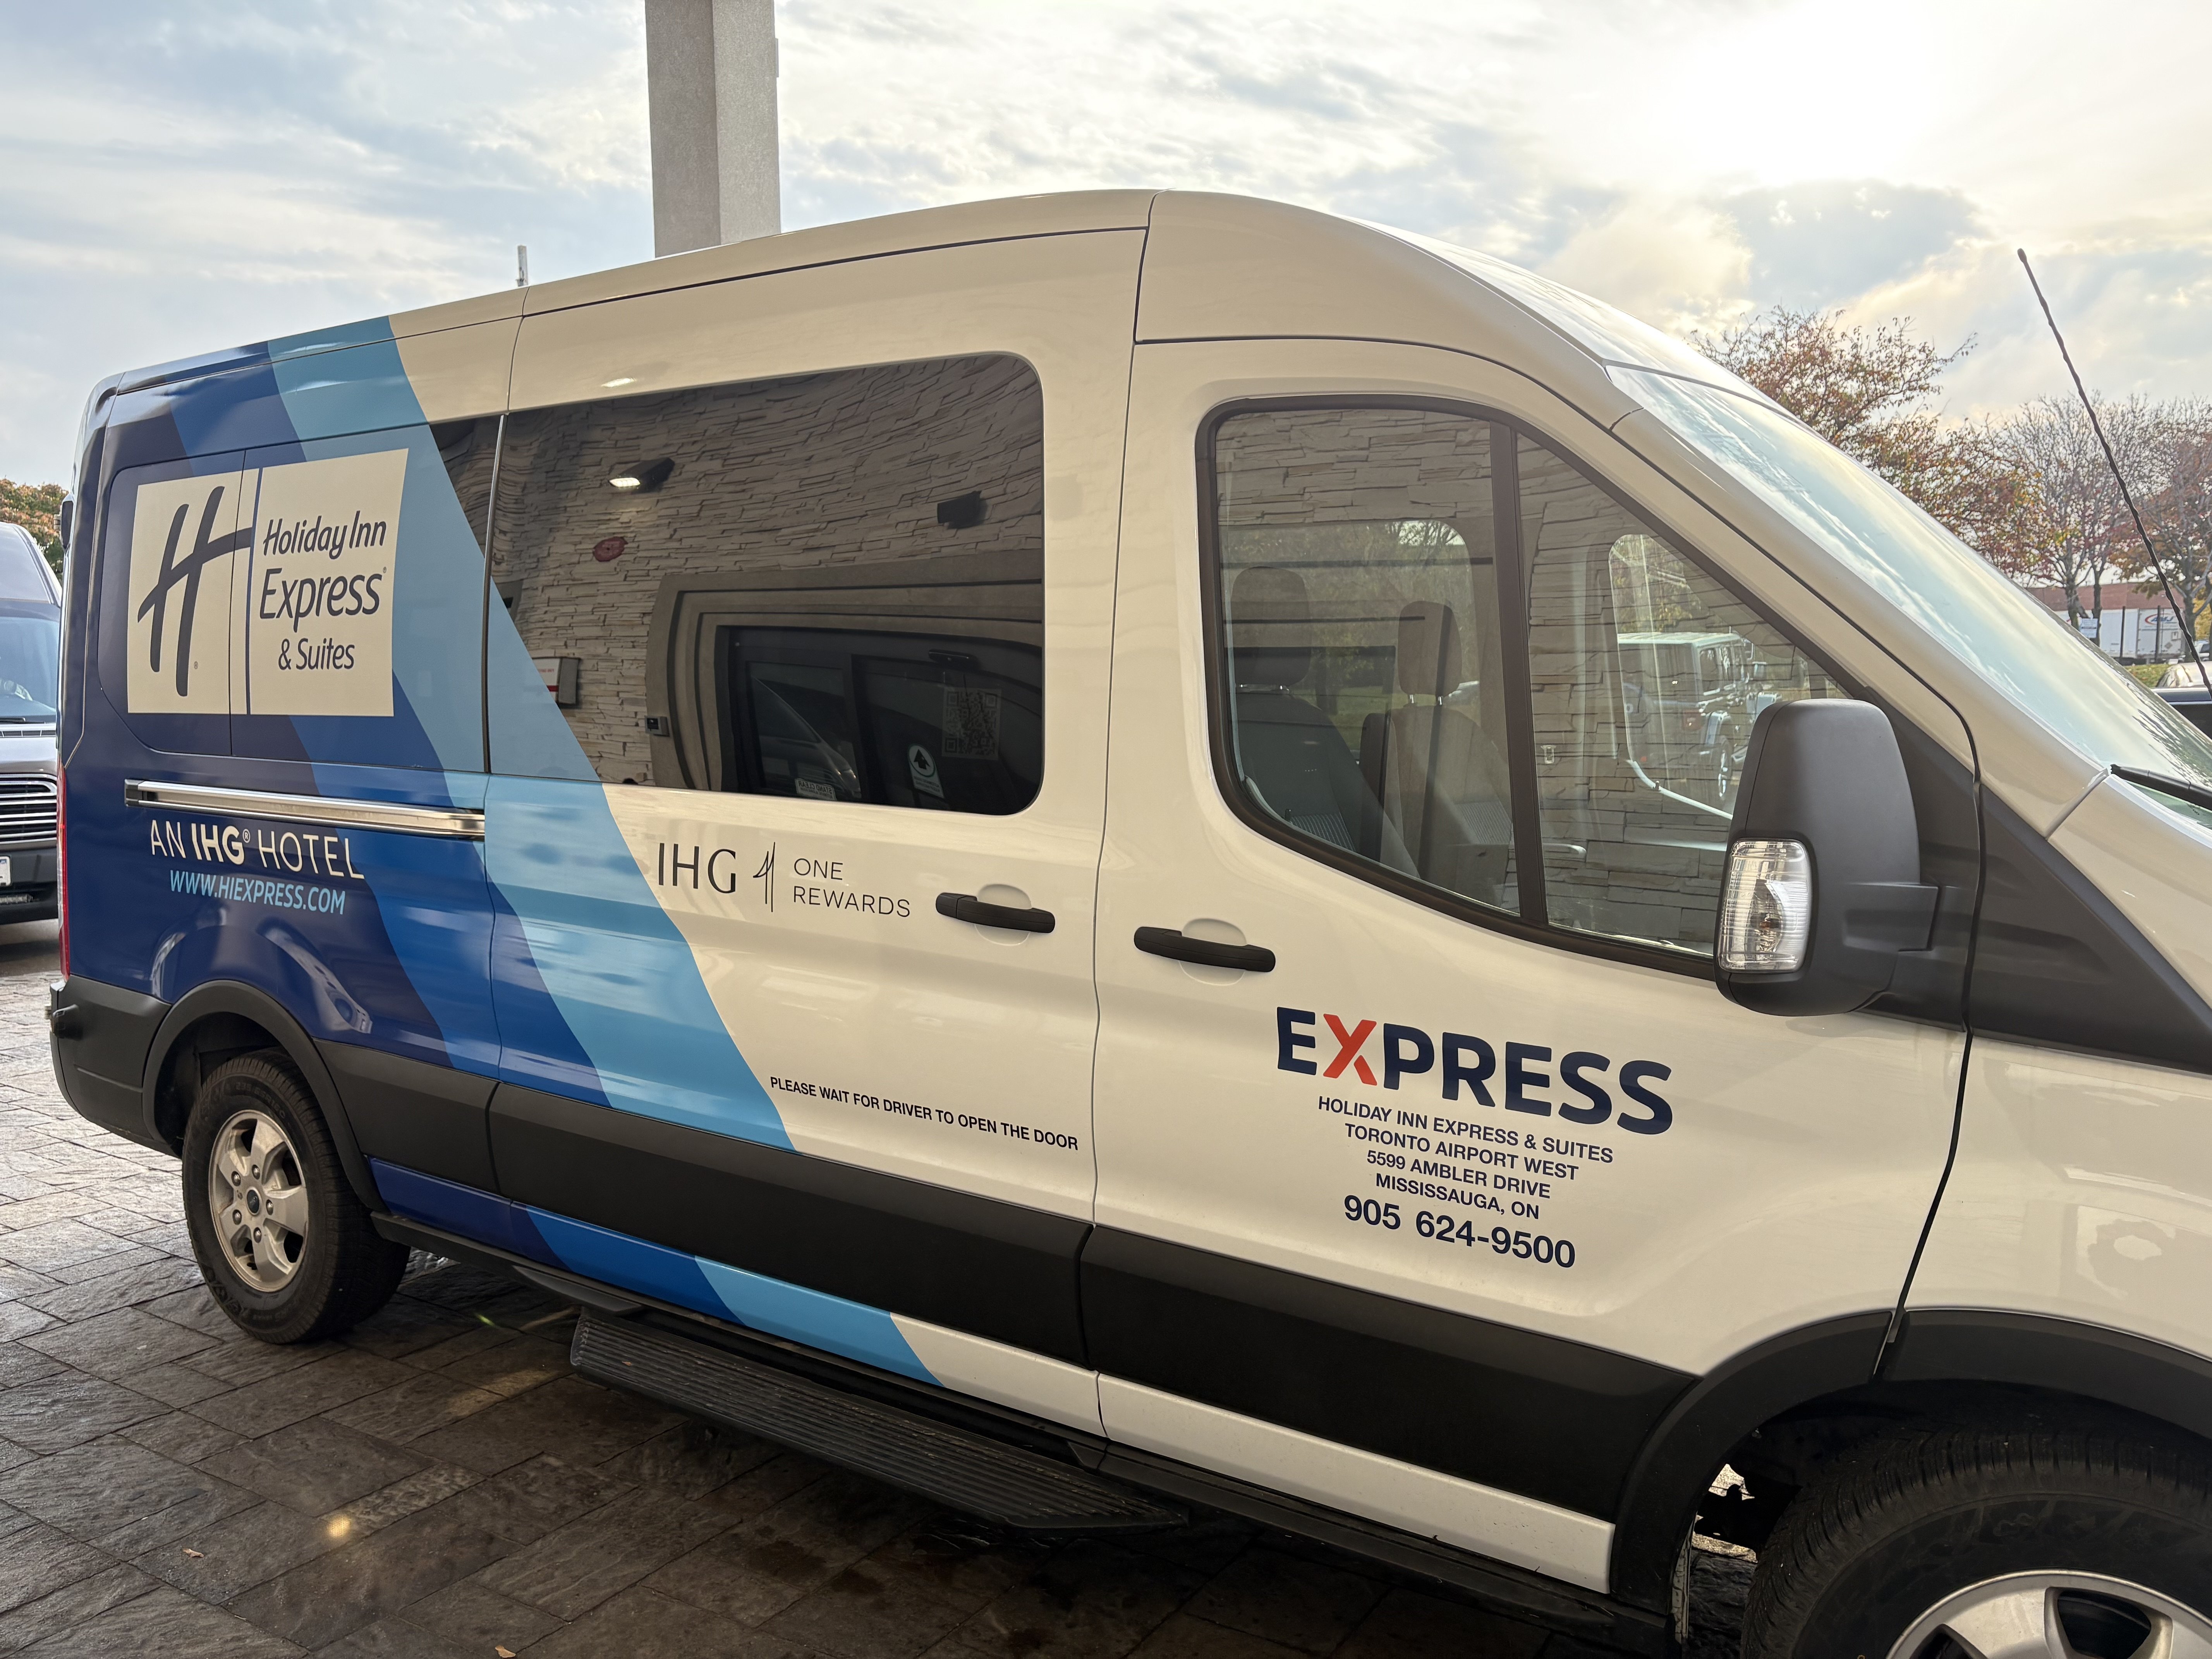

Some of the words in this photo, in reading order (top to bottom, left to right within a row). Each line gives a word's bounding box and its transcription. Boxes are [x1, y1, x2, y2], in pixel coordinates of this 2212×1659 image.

[263, 516, 347, 559] Holiday
[349, 511, 386, 548] Inn
[278, 639, 291, 670] &
[296, 638, 354, 670] Suites
[151, 820, 185, 858] AN
[258, 830, 364, 879] HOTEL
[659, 843, 735, 893] IHG
[794, 859, 843, 880] ONE
[170, 870, 345, 914] WWW.HIEXPRESS.COM
[794, 886, 910, 917] REWARDS
[1277, 1007, 1672, 1135] EXPRESS
[771, 1077, 816, 1096] PLEASE
[819, 1086, 849, 1103] WAIT
[854, 1093, 879, 1109] FOR
[884, 1099, 932, 1120] DRIVER
[936, 1109, 953, 1124] TO
[958, 1115, 996, 1133] OPEN
[1001, 1123, 1029, 1140] THE
[1034, 1129, 1078, 1150] DOOR
[1319, 1096, 1392, 1121] HOLIDAY
[1397, 1111, 1427, 1128] INN
[1434, 1117, 1518, 1146] EXPRESS
[1525, 1134, 1537, 1149] &
[1543, 1137, 1613, 1163] SUITES
[1345, 1123, 1430, 1152] TORONTO
[1435, 1141, 1518, 1169] AIRPORT
[1524, 1157, 1578, 1180] WEST
[1367, 1150, 1405, 1170] 5599
[1410, 1160, 1487, 1186] AMBLER
[1494, 1175, 1550, 1198] DRIVE
[1376, 1173, 1505, 1215] MISSISSAUGA,
[1511, 1202, 1539, 1219] ON
[1345, 1195, 1400, 1230] 905
[1416, 1210, 1575, 1267] 624-9500
